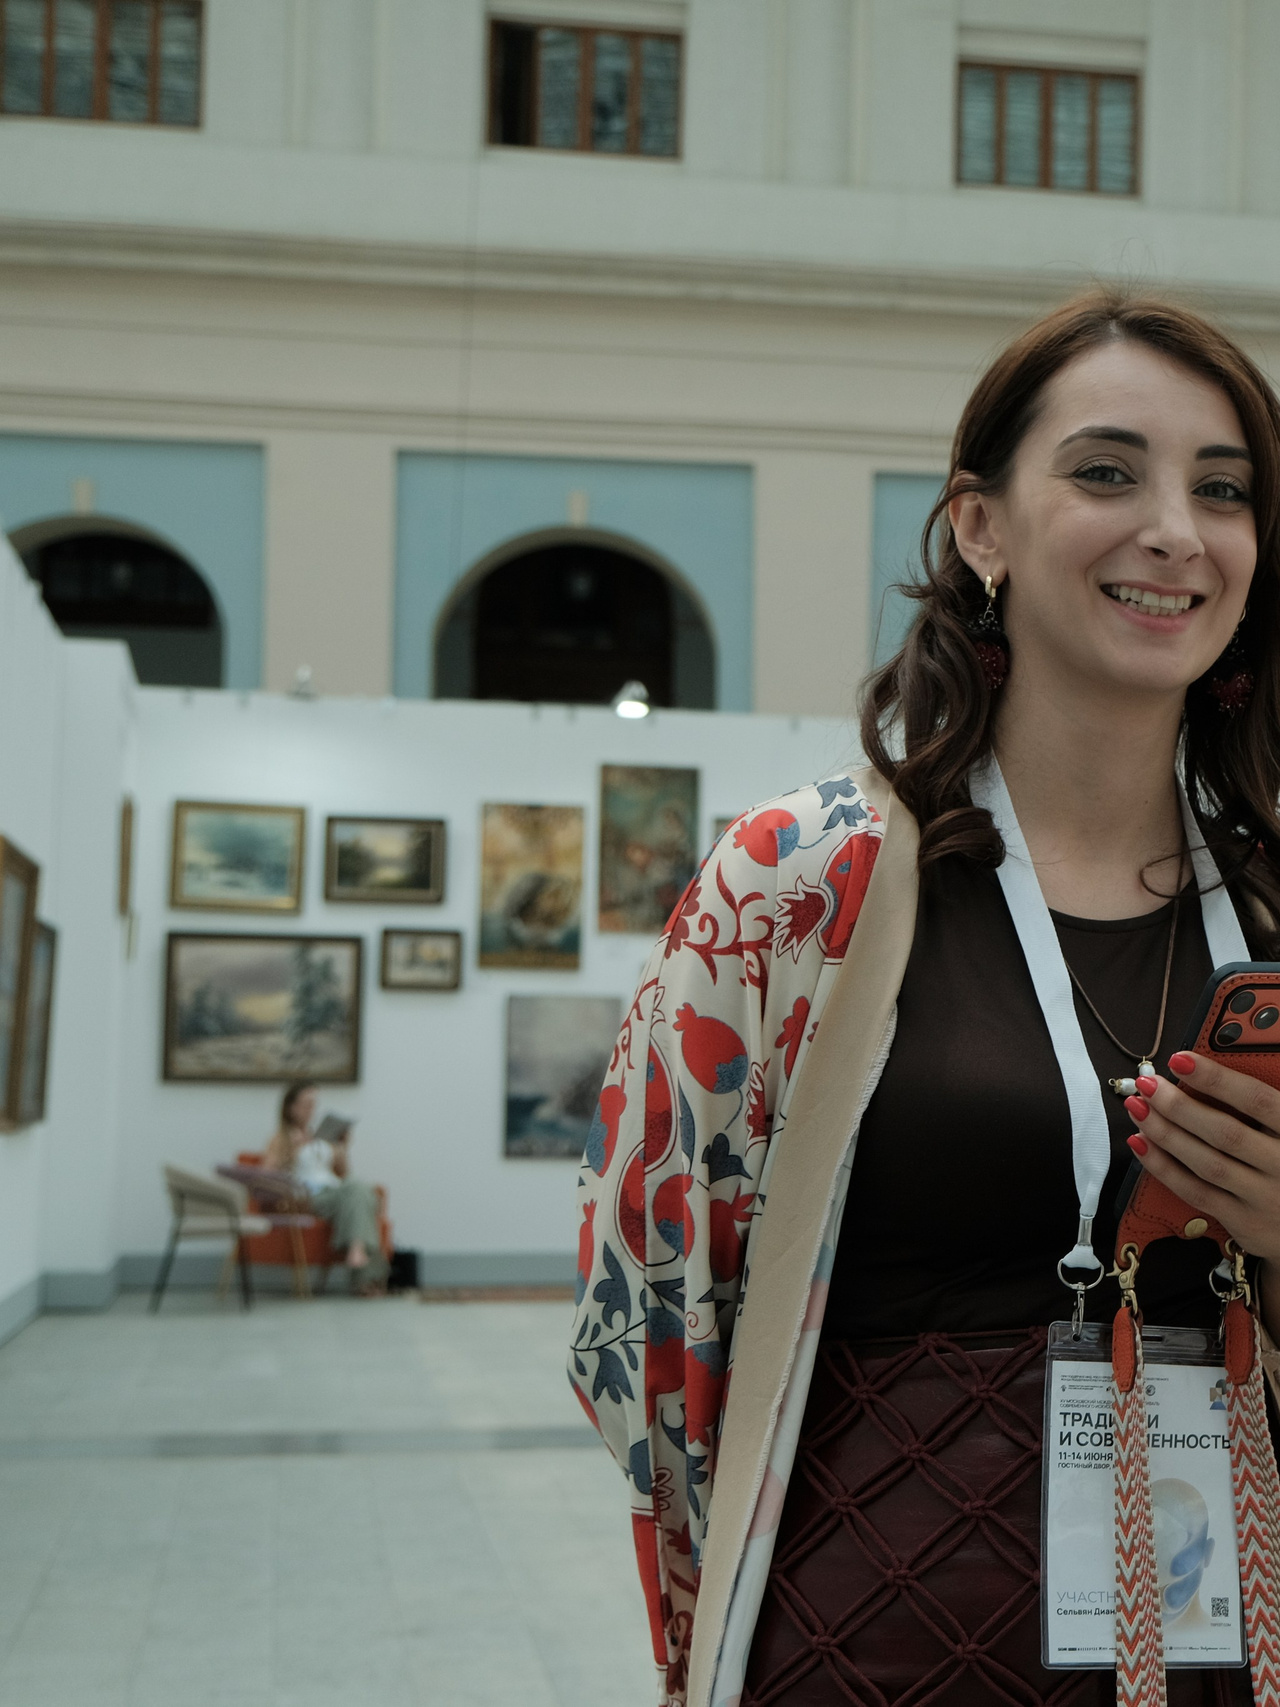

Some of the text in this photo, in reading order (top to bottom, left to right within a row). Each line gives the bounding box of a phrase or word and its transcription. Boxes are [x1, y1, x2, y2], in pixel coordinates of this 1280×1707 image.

[1059, 1411, 1159, 1429] ТРАДИ
[1059, 1431, 1232, 1449] И СОВЕННОСТЬ
[1058, 1451, 1113, 1461] 11-14 ИЮНЯ
[1057, 1461, 1092, 1469] ГОСТИНЫЙ
[1056, 1591, 1117, 1604] УЧАСТН
[1056, 1607, 1118, 1616] Сельвян Диан
